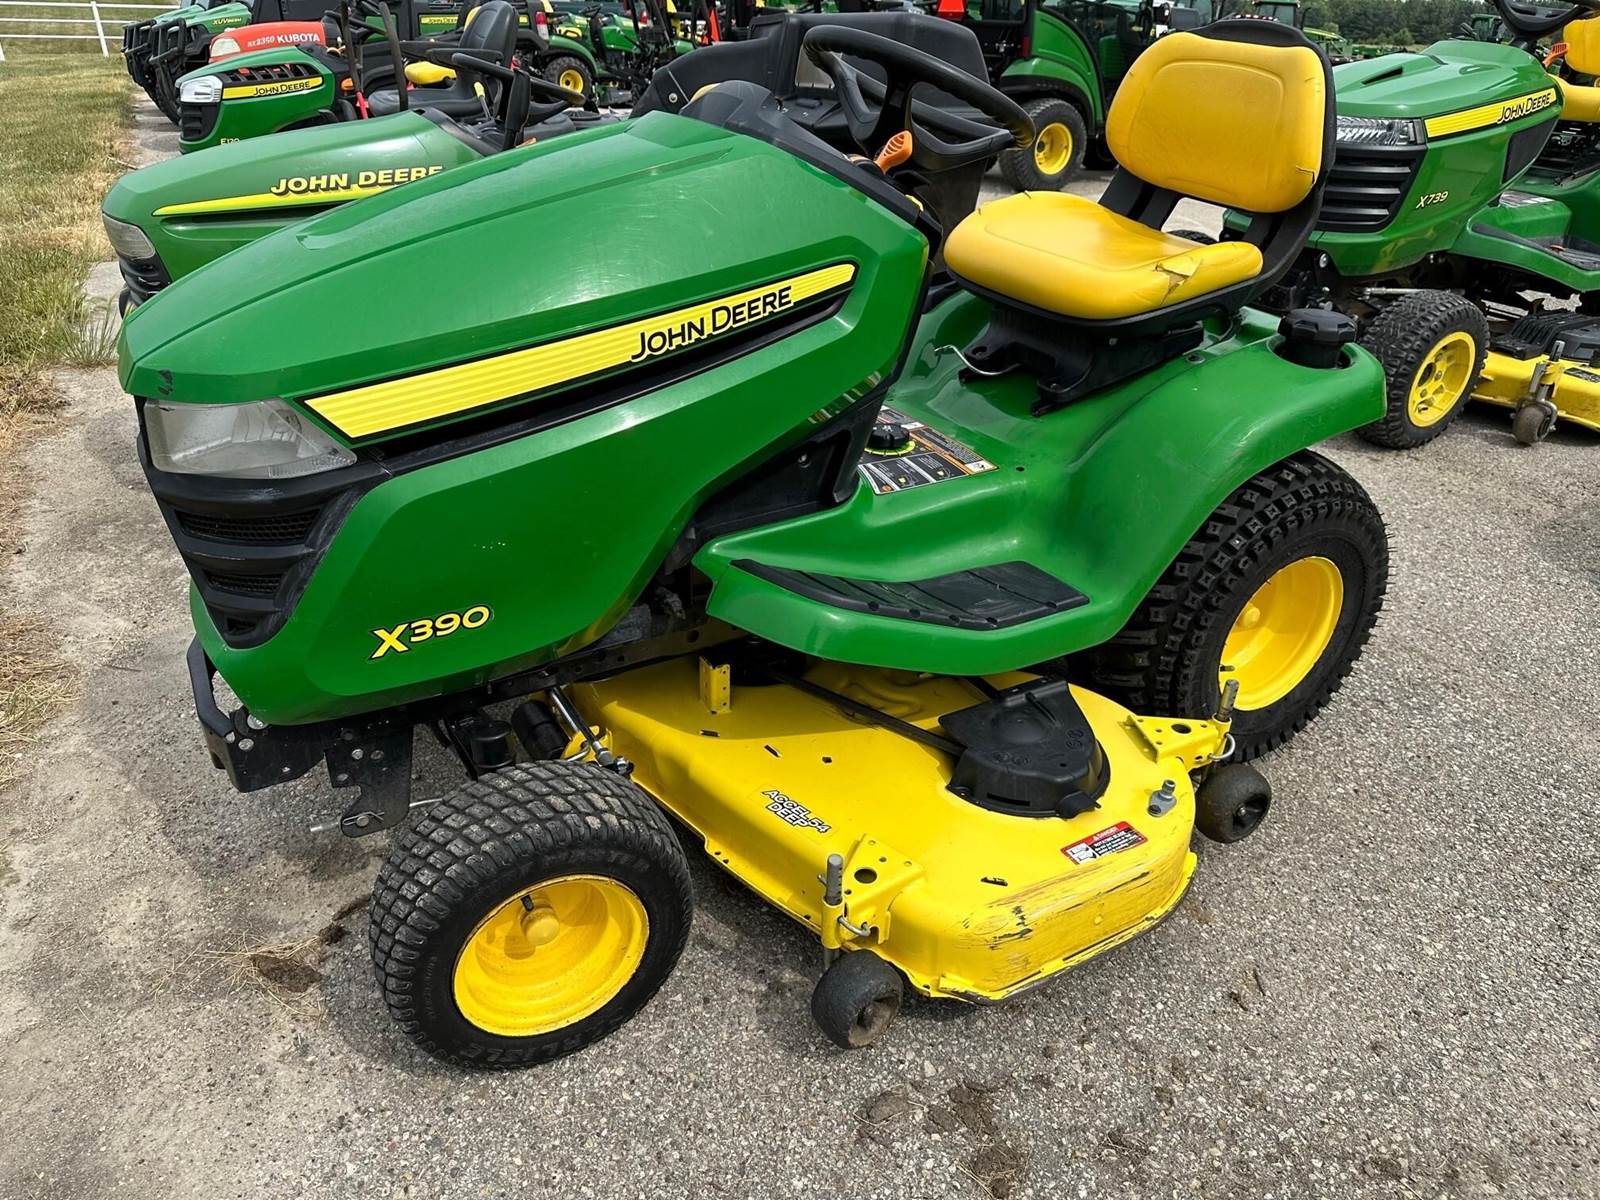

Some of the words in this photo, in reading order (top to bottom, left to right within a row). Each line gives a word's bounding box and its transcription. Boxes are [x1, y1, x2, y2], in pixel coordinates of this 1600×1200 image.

[276, 33, 320, 44] KUBOTA
[253, 86, 279, 96] JOHN
[280, 81, 310, 92] DEERE
[1497, 102, 1525, 124] JOHN
[1525, 92, 1552, 114] DEERE
[270, 173, 351, 196] JOHN
[1416, 190, 1449, 209] X739
[631, 317, 706, 362] JOHN
[711, 285, 793, 335] DEERE
[369, 604, 491, 660] X390
[761, 789, 812, 820] ACCEL
[808, 816, 832, 834] 54
[765, 801, 810, 827] DEEP
